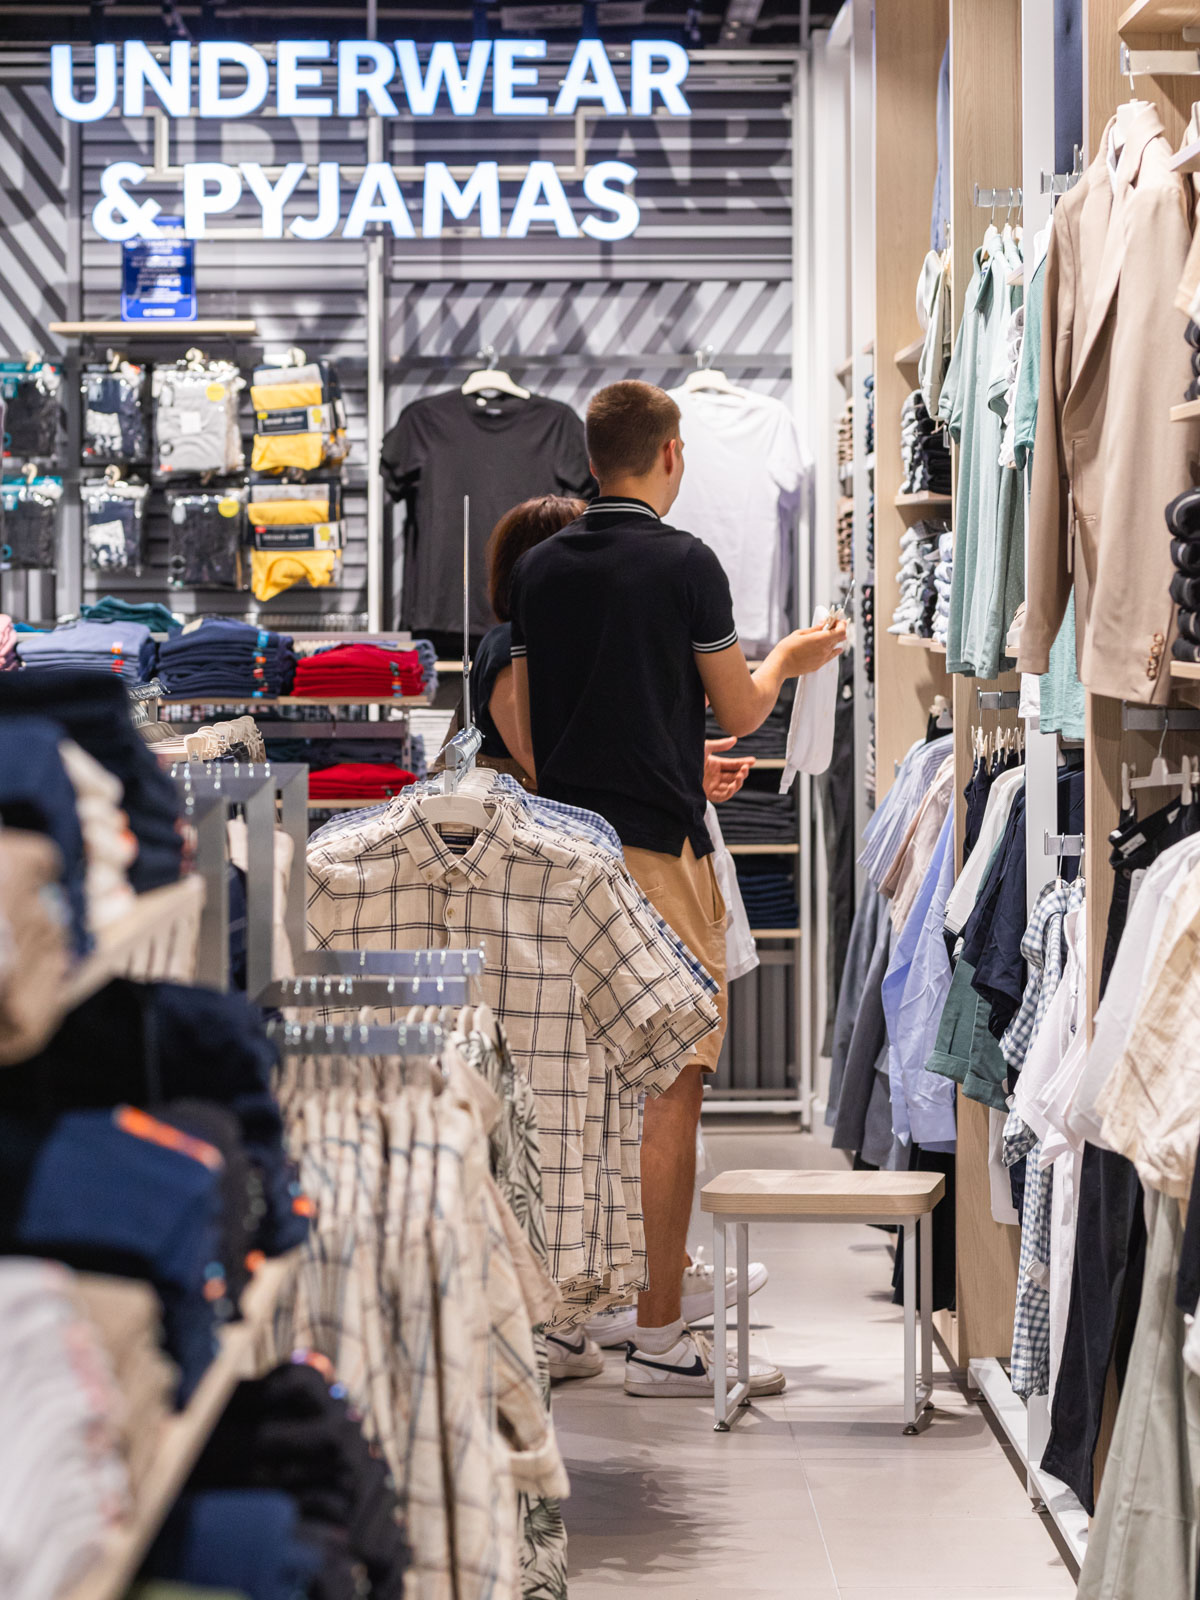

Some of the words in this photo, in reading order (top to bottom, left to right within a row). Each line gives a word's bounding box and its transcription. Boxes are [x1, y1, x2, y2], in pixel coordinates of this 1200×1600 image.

[51, 40, 692, 122] UNDERWEAR
[92, 161, 162, 241] &
[183, 161, 640, 241] PYJAMAS
